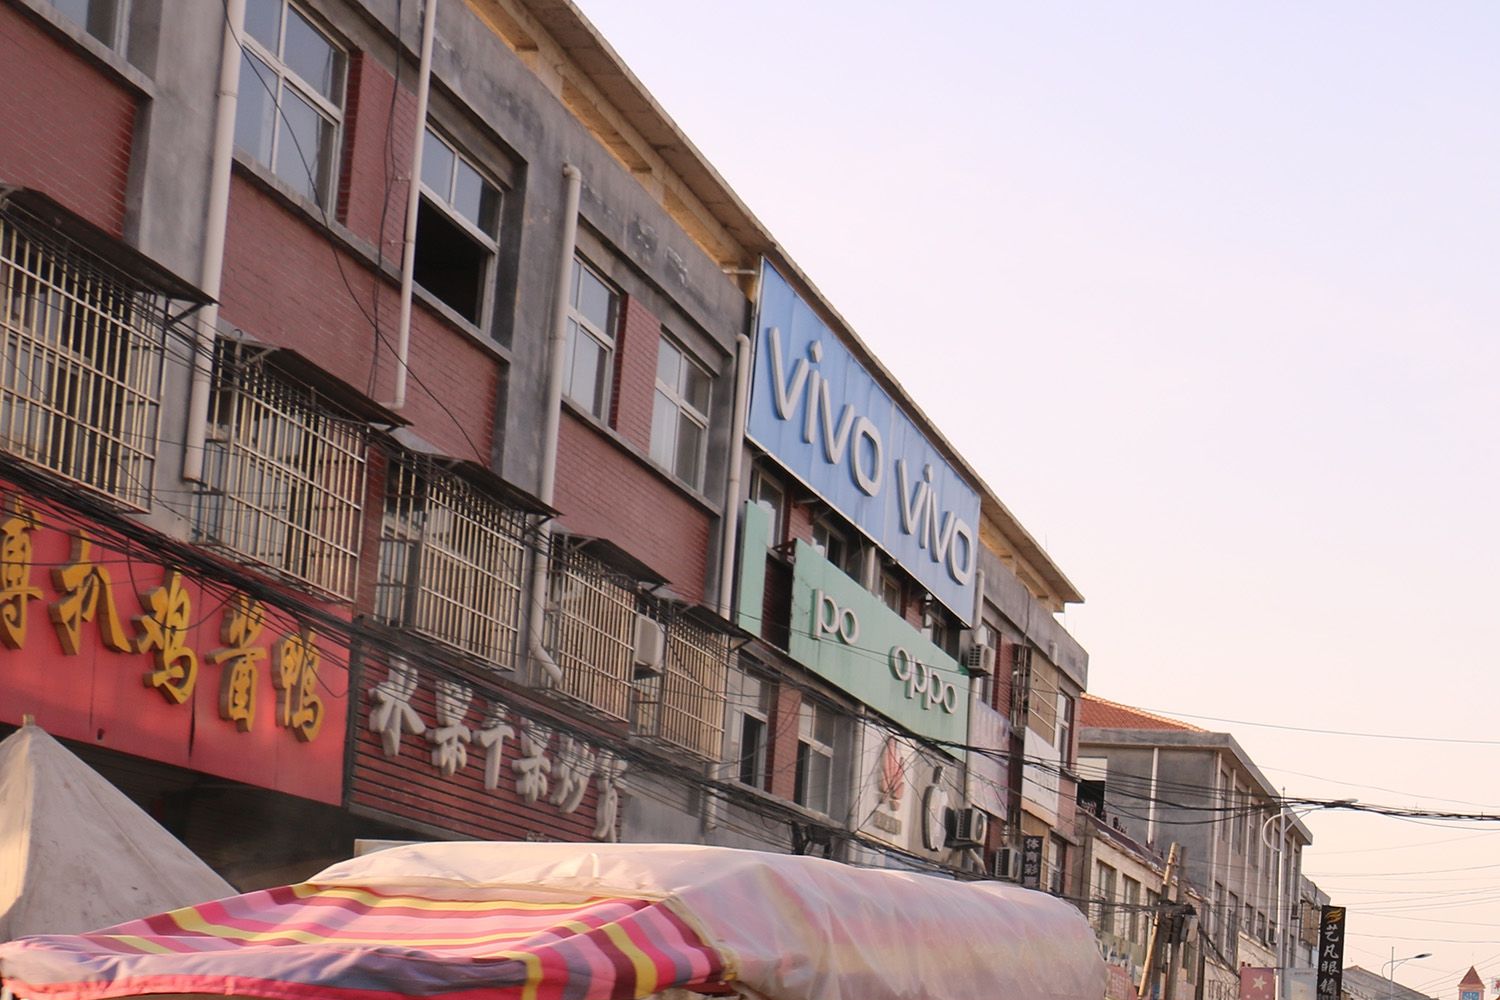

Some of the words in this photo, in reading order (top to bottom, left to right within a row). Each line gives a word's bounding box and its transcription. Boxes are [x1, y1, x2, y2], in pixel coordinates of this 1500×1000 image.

[768, 327, 882, 497] vivo
[896, 458, 972, 586] vivo
[812, 588, 860, 645] po
[889, 645, 958, 714] oppo
[1319, 924, 1340, 999] 艺凡眼镜
